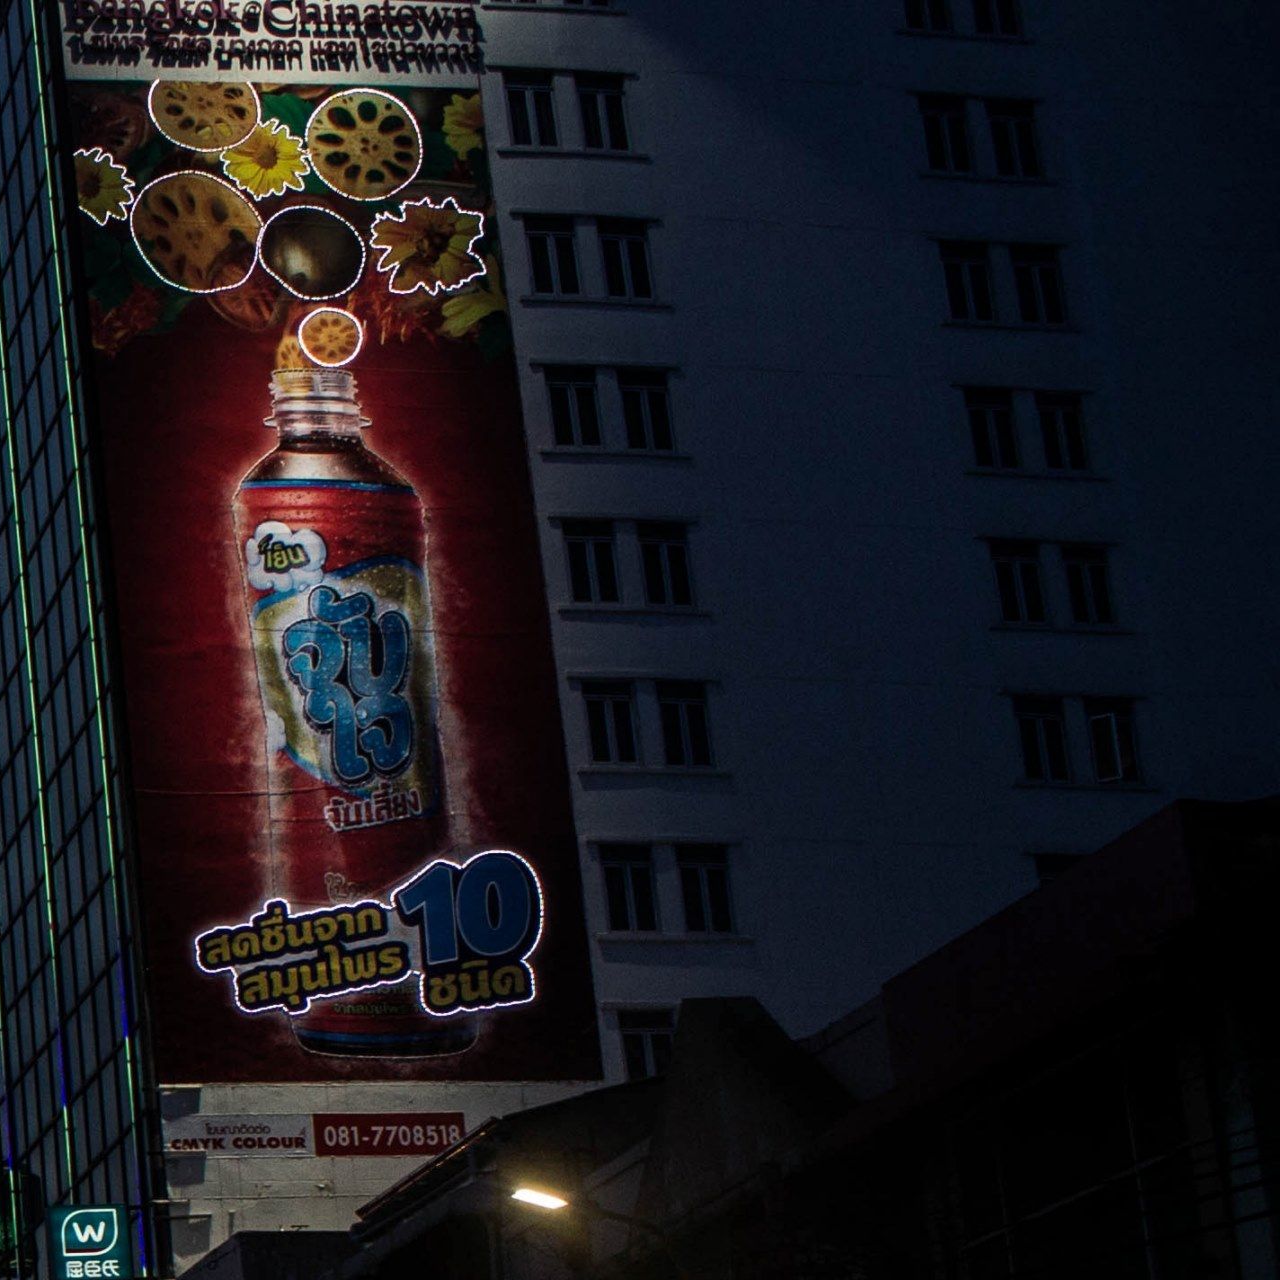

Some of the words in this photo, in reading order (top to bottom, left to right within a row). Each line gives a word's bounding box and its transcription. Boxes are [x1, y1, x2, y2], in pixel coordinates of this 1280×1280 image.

[397, 850, 533, 965] 10
[202, 905, 385, 967] สดชื่นจาก
[238, 943, 408, 1009] สมุนไพร
[427, 957, 528, 1009] ชนิด
[171, 1137, 224, 1150] CMYK
[233, 1136, 305, 1150] COLOUR
[323, 1125, 461, 1148] 081-7708518
[72, 1220, 106, 1243] W
[66, 1259, 120, 1278] 屈臣氏
